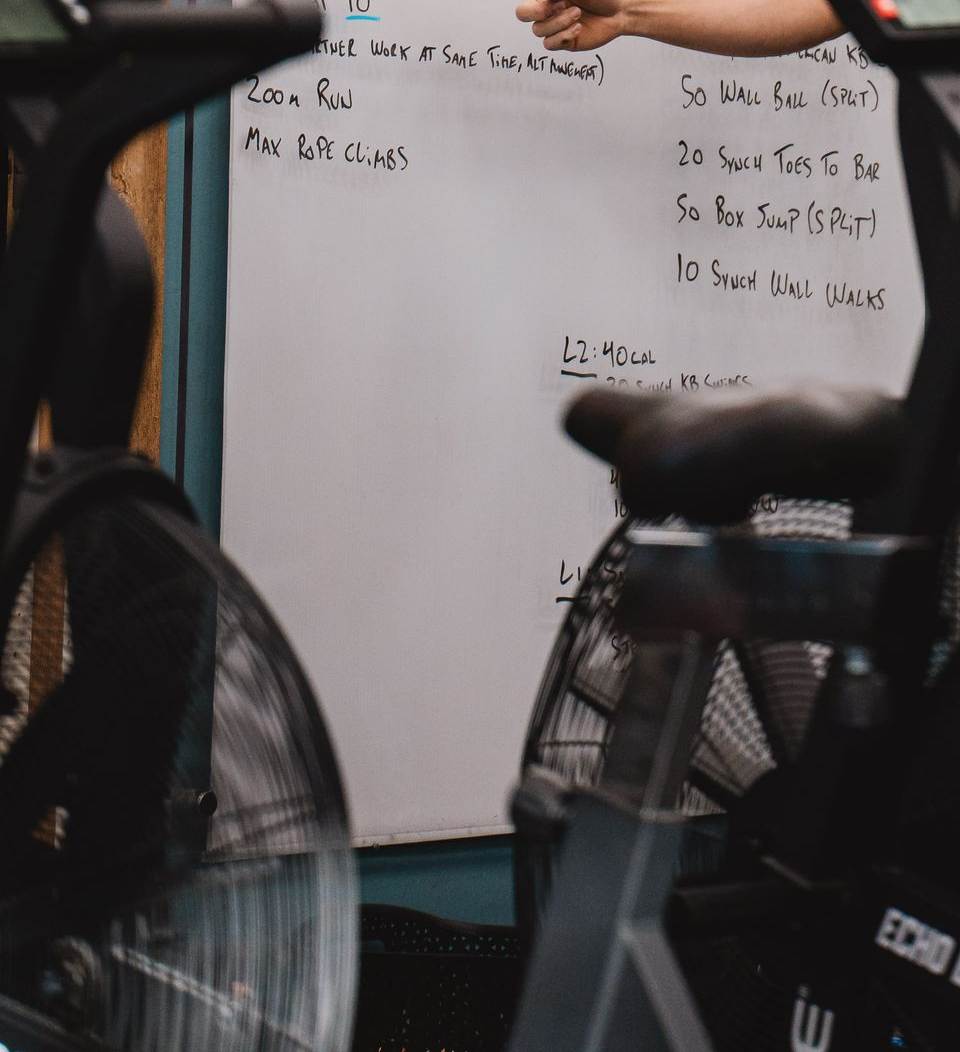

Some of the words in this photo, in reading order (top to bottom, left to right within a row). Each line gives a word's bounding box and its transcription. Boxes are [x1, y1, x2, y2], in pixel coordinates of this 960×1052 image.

[370, 39, 409, 62] WORK
[418, 46, 437, 62] AT
[442, 46, 478, 67] SAME
[526, 53, 548, 71] ALT
[317, 77, 353, 110] RUN
[681, 74, 707, 109] 50
[720, 79, 761, 106] WALL
[774, 80, 808, 112] BALL
[245, 125, 282, 158] MAX
[298, 133, 335, 161] ROPE
[678, 140, 704, 166] 20
[719, 145, 763, 175] SYNCH
[774, 143, 812, 179] TOES
[820, 150, 839, 176] TO
[854, 152, 880, 183] BAR
[677, 193, 700, 223] 50
[715, 194, 744, 228] BOX
[757, 202, 800, 234] JUMP
[677, 252, 699, 283] 10
[712, 258, 757, 292] SYNCH
[770, 269, 814, 300] WALL
[826, 282, 886, 311] WALKS
[562, 335, 597, 364] L2:
[874, 907, 957, 977] ECHO
